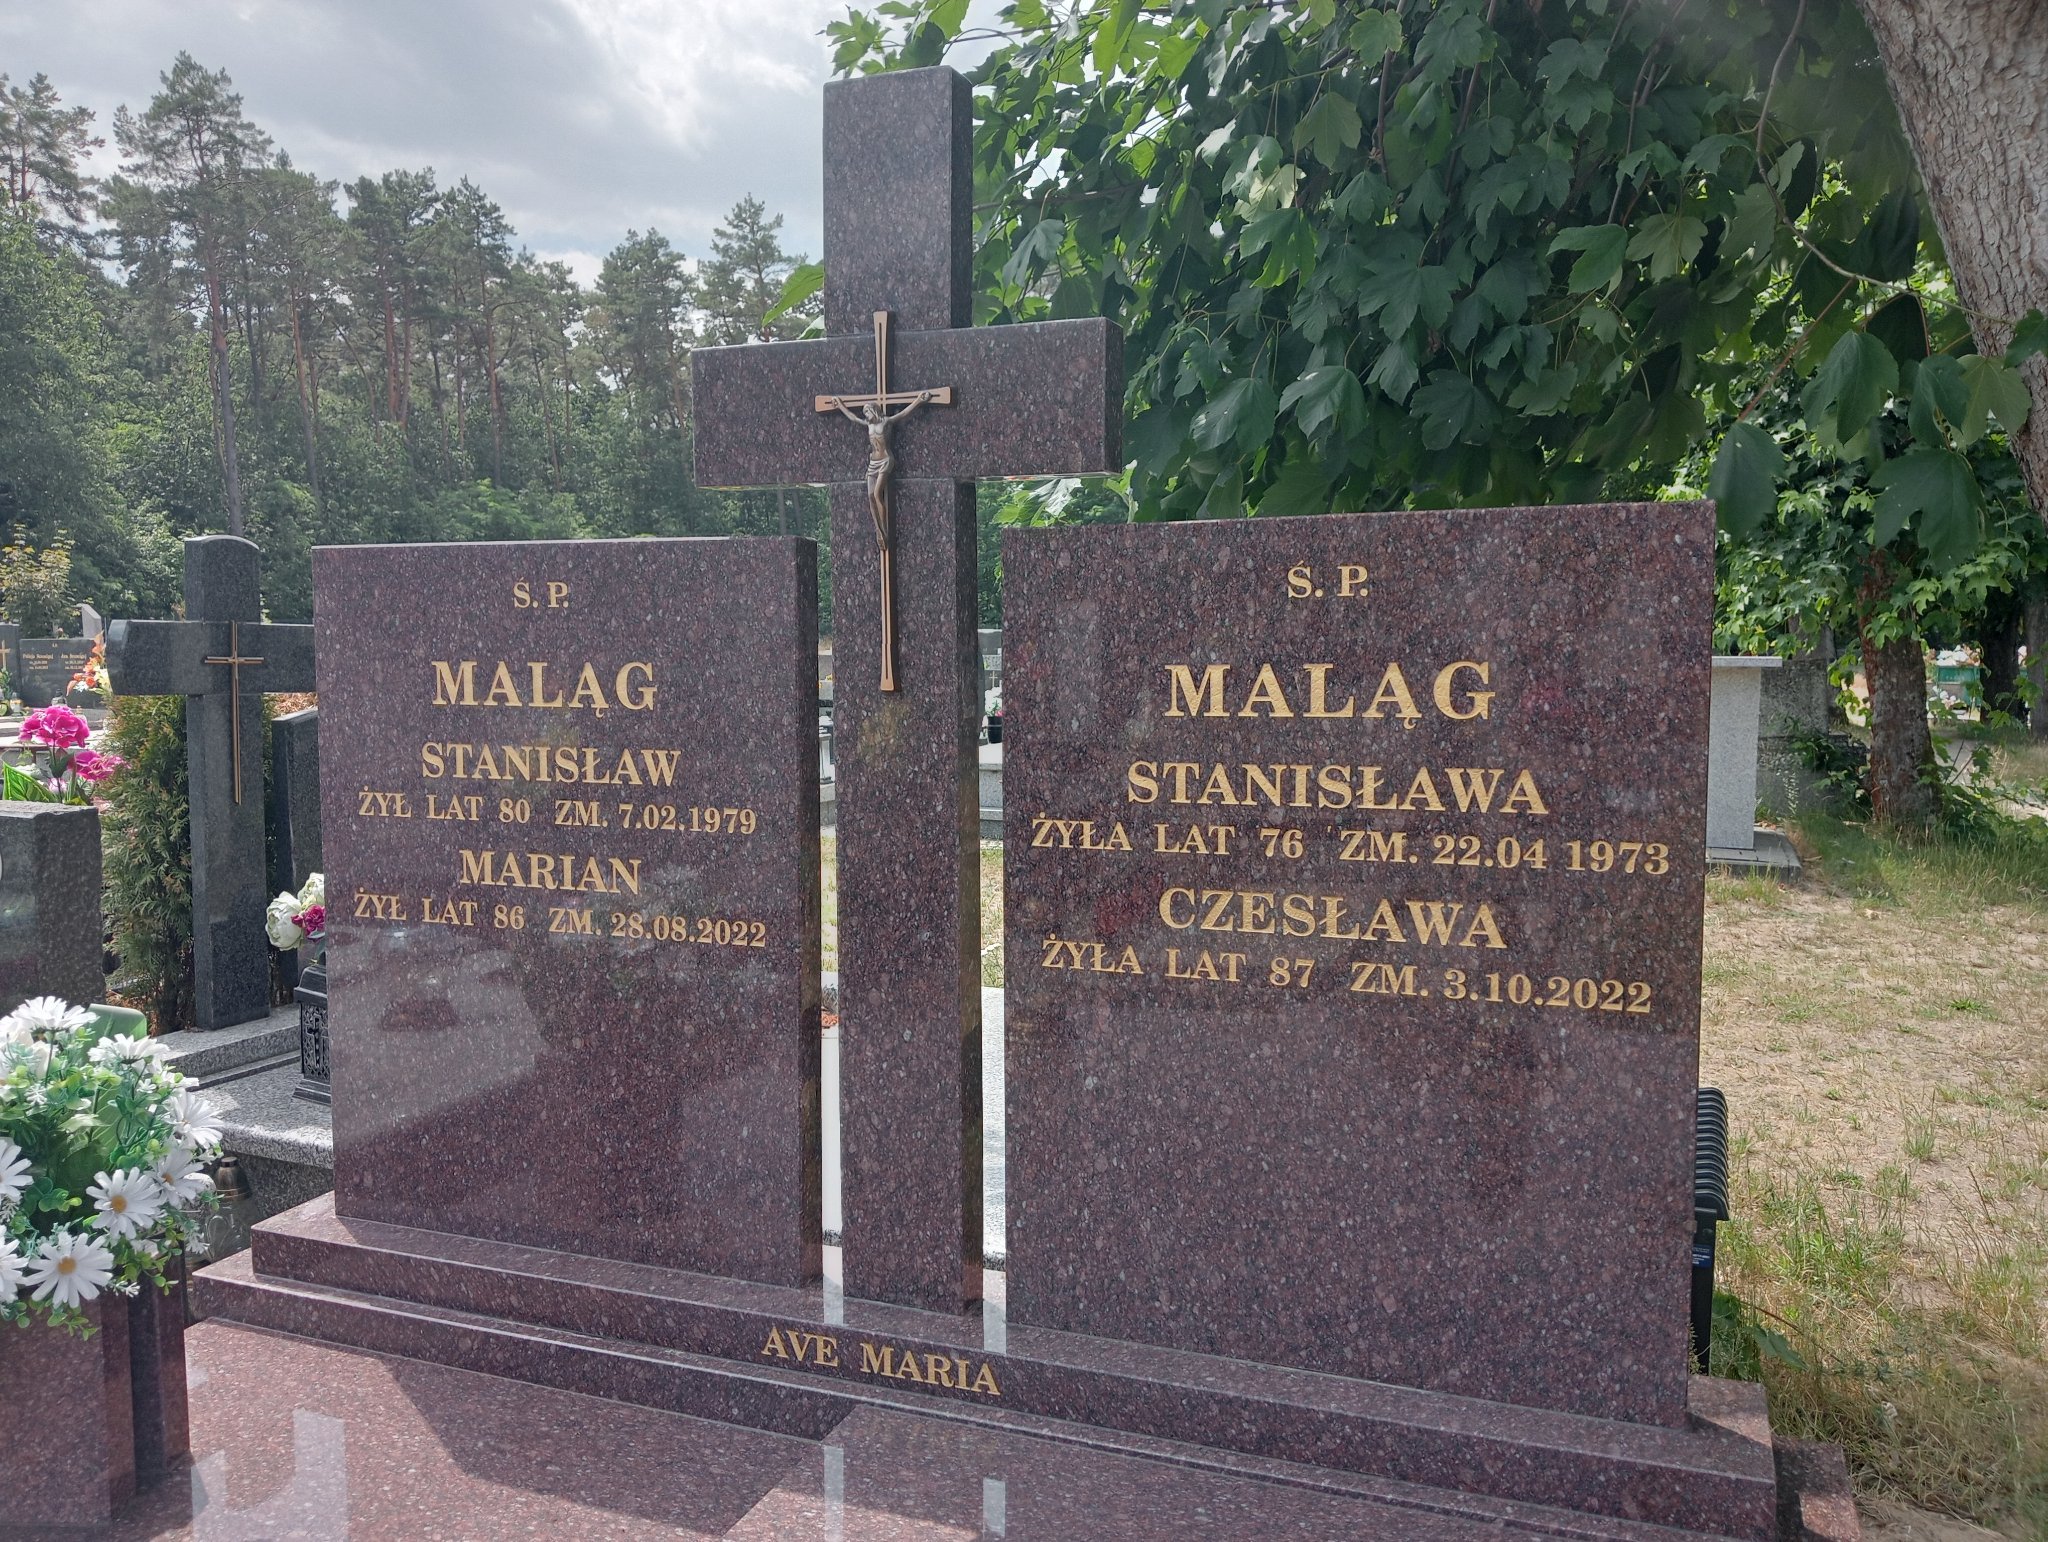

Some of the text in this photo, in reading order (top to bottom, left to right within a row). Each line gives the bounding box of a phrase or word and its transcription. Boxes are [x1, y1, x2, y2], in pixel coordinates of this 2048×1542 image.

[432, 660, 658, 718] MALĄG
[1164, 661, 1496, 730] MALĄG
[421, 741, 682, 786] STANISŁAW
[1128, 760, 1549, 815] STANISŁAWA
[358, 785, 757, 835] ŻYŁ LAT 80 ZM. 7.02.1979
[459, 849, 642, 895] MARIAN
[1031, 811, 1671, 875] ŻYŁA LAT 76 ZM. 22.04 1973
[354, 887, 766, 947] ŻYŁ LAT 86 ZM. 28.08.2022
[1159, 887, 1508, 949] CZESŁAWA
[1041, 933, 1652, 1014] ŻYŁA LAT 87 ZM. 3.10.2022
[761, 1326, 1001, 1396] AVE MARIA
